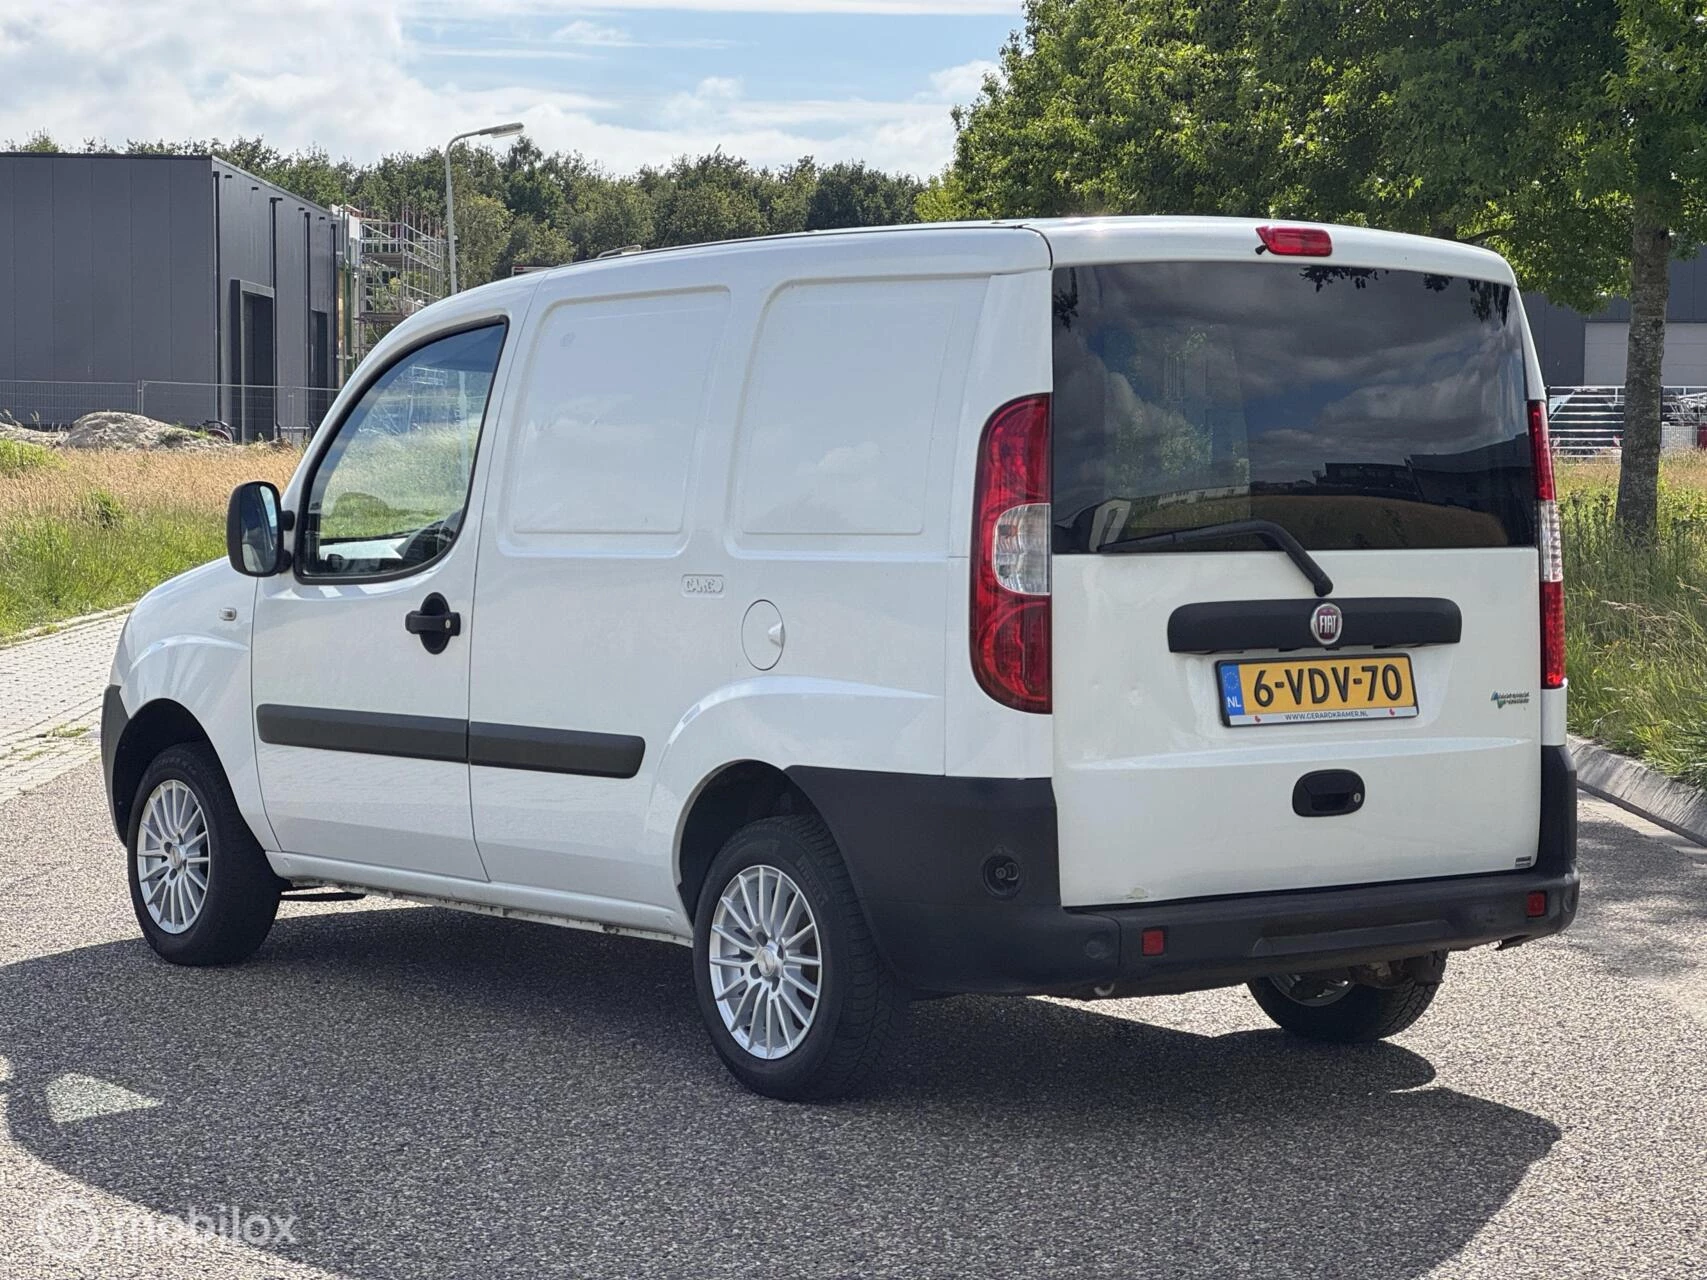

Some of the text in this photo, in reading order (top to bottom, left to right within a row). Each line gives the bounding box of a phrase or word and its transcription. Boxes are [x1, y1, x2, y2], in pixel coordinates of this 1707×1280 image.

[1319, 615, 1337, 634] FIAT
[1253, 663, 1403, 708] 6-VDV-70
[1227, 696, 1242, 708] NL
